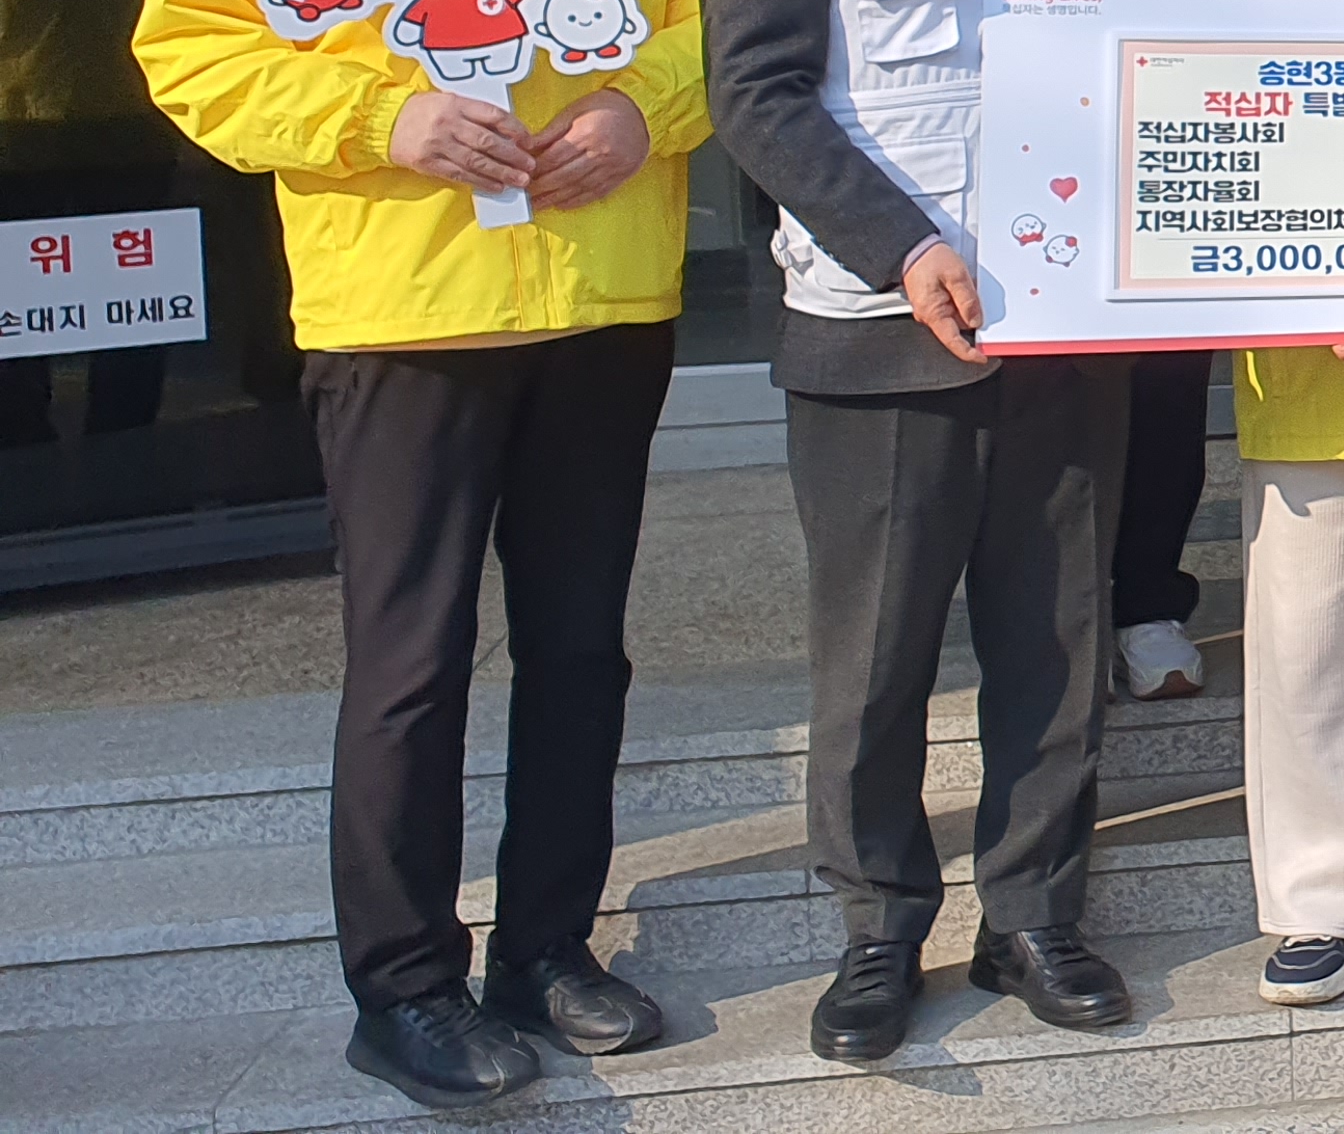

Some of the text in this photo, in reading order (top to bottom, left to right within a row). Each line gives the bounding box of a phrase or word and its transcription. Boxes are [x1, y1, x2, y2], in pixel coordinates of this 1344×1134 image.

[1046, 4, 1102, 16] 생명입니다.
[1204, 92, 1293, 118] 적십자
[1137, 121, 1285, 145] 적십자봉사회
[1137, 150, 1261, 174] 주민자치회
[1137, 179, 1261, 204] 통장자율회
[0, 294, 195, 337] 손대지 마세요
